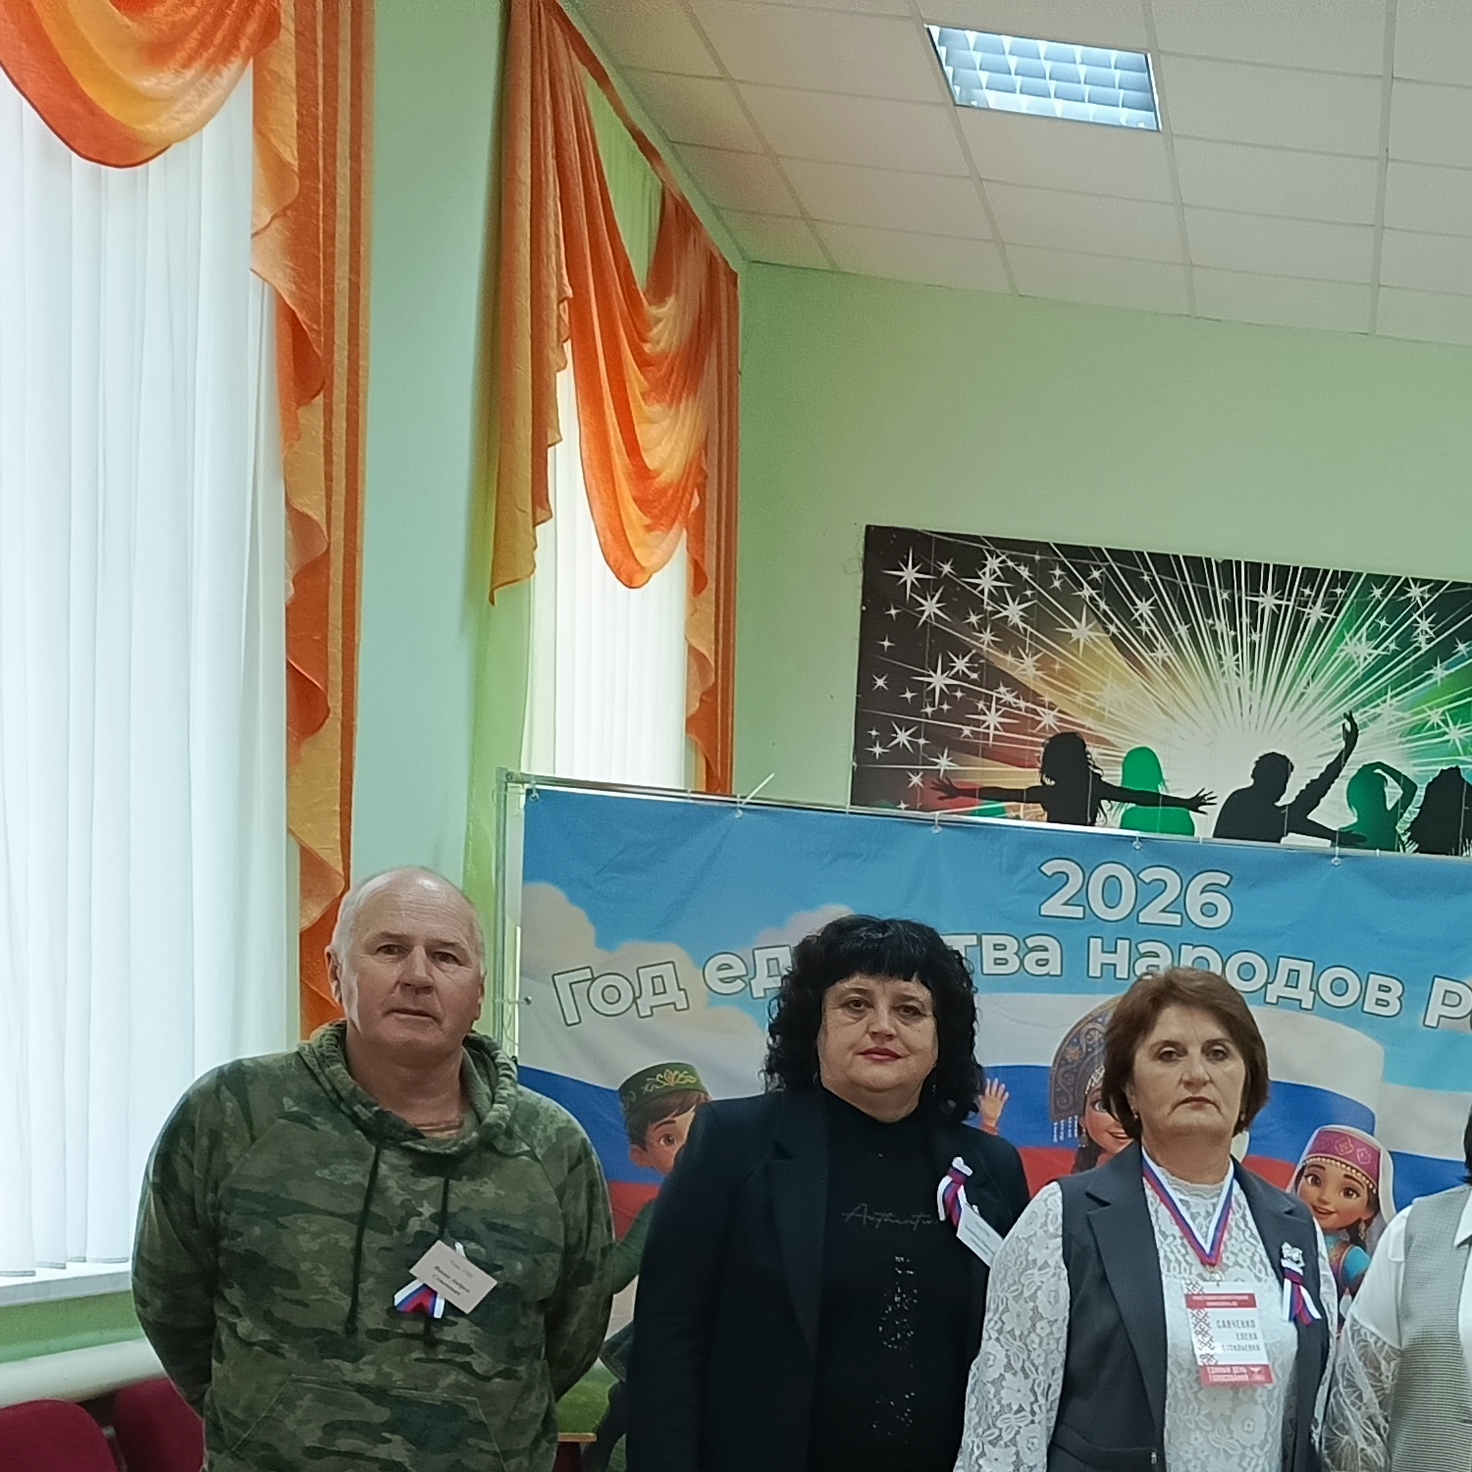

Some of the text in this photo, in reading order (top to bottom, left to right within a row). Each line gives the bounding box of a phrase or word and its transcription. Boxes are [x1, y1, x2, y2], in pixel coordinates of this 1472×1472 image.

[1039, 857, 1233, 929] 2026
[552, 961, 690, 1026] Год
[703, 933, 1063, 999] едтва
[1087, 936, 1405, 1017] народов
[1216, 1319, 1256, 1329] САВЧЕНКО
